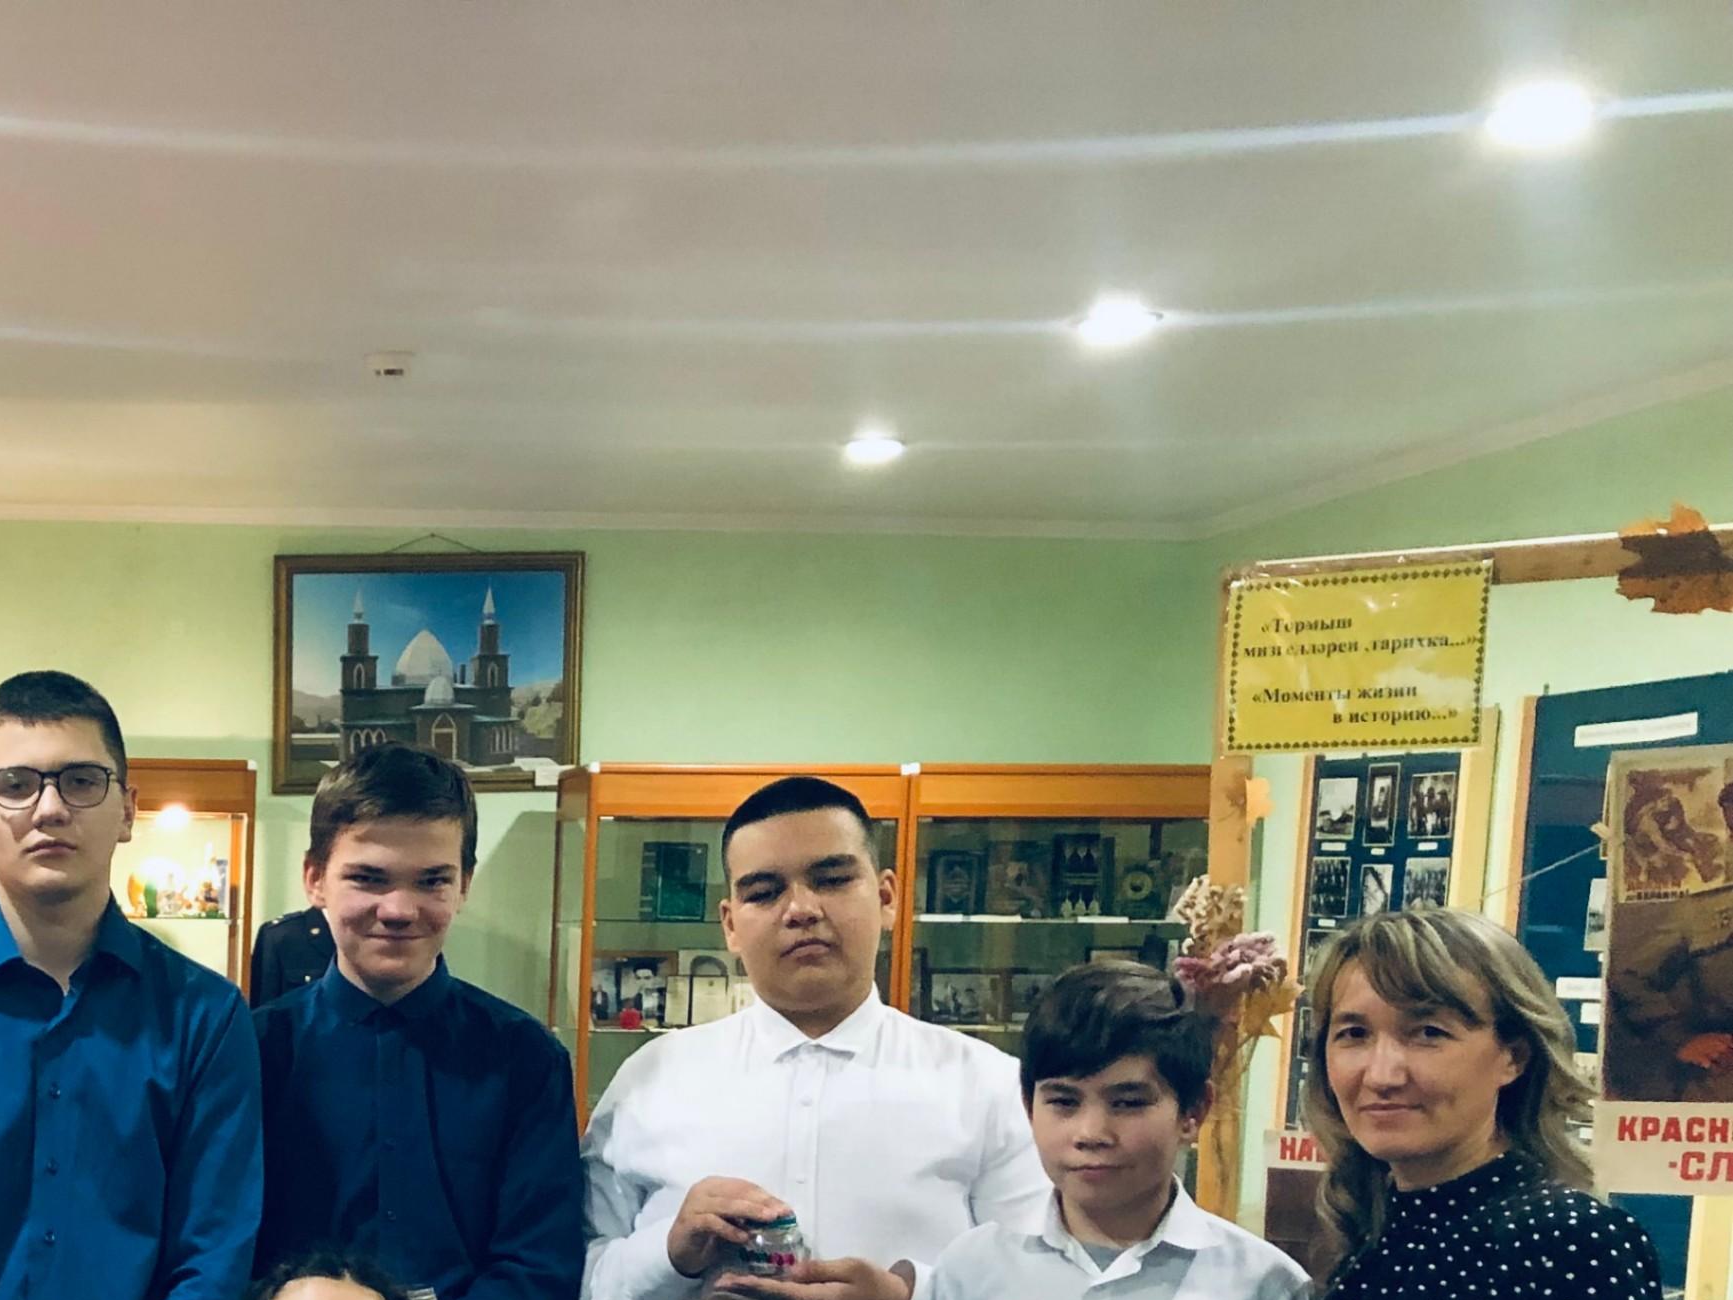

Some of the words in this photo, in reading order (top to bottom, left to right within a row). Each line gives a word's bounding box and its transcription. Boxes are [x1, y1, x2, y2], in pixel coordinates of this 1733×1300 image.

[1252, 688, 1352, 704] «Моменты
[1357, 686, 1418, 700] жизни
[1332, 712, 1343, 724] в
[1618, 1115, 1731, 1144] КРАСН
